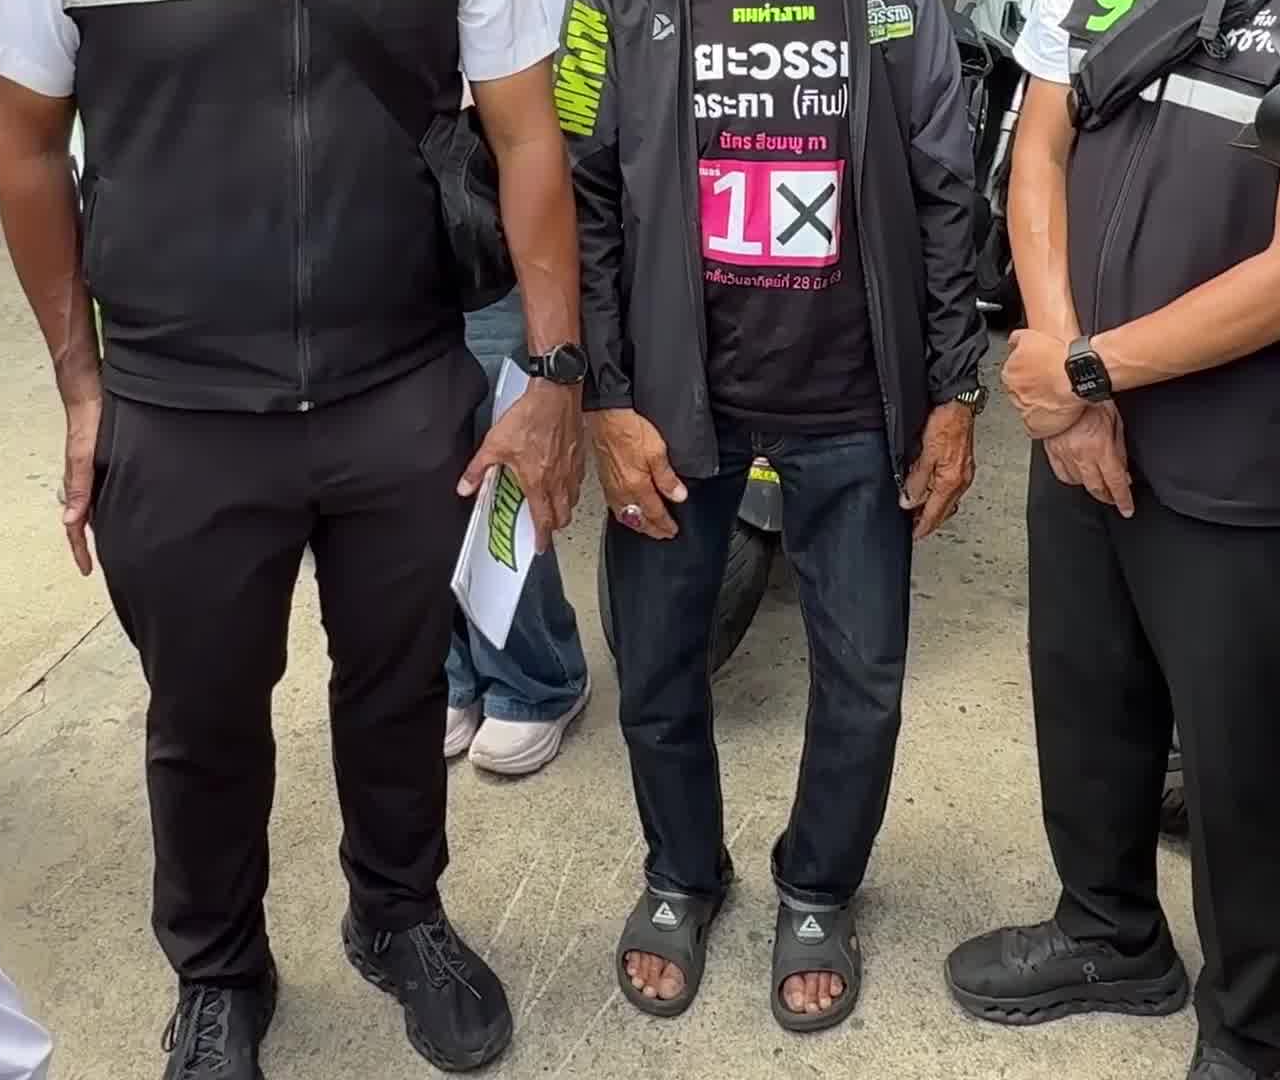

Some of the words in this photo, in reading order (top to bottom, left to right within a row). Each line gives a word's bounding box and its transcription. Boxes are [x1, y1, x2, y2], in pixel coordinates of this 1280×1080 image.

[732, 3, 816, 23] คนทำงาน
[694, 40, 849, 80] ยะวรร
[792, 83, 849, 120] (กิฟ)
[719, 131, 751, 150] บัตร
[755, 133, 803, 155] สีชมพู
[808, 135, 828, 150] กา
[708, 170, 763, 256] 1
[793, 276, 810, 289] 28
